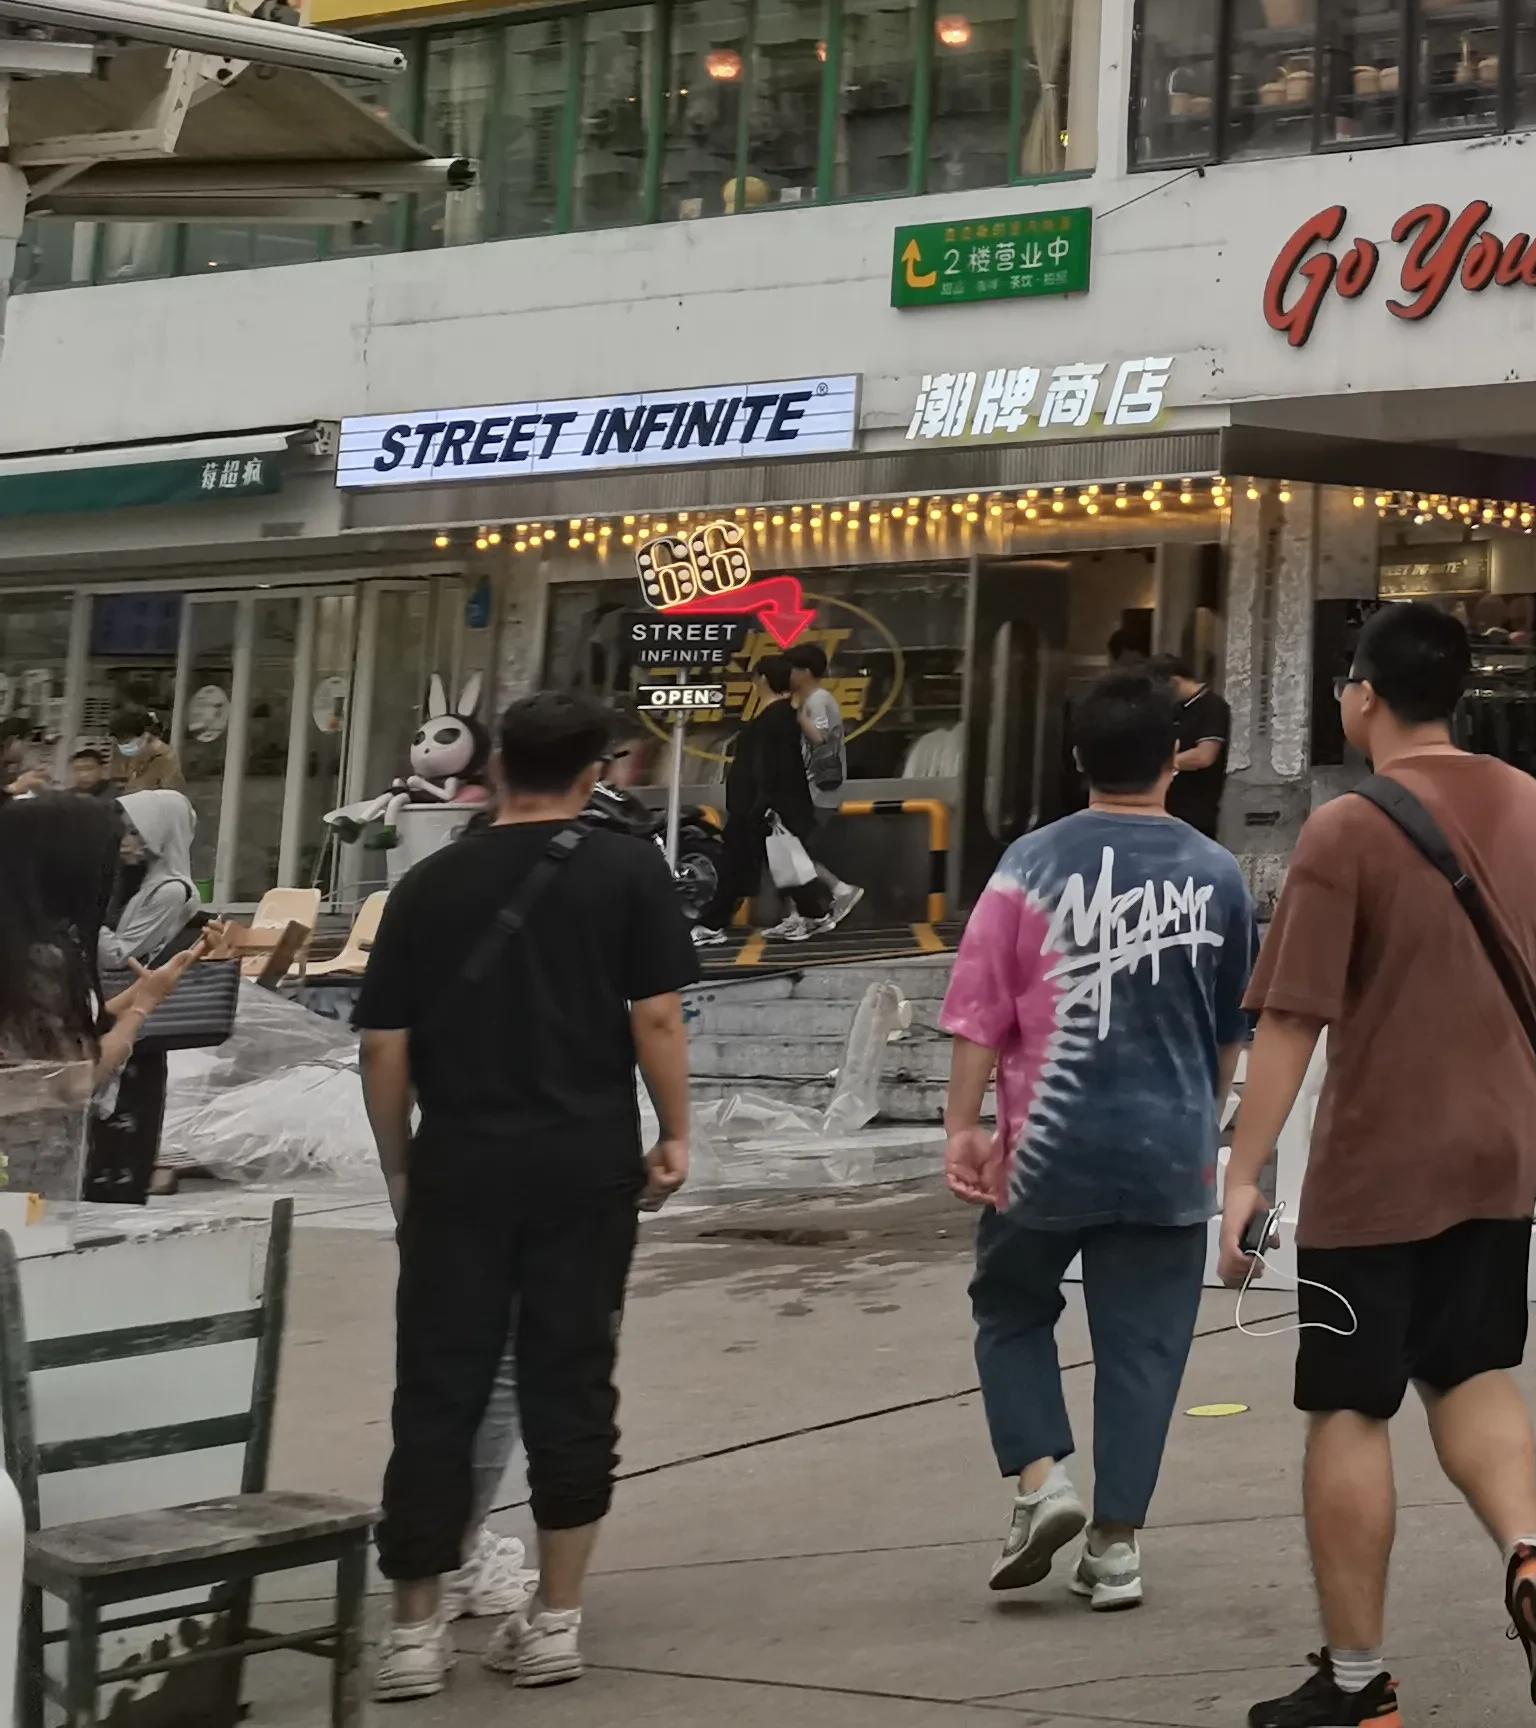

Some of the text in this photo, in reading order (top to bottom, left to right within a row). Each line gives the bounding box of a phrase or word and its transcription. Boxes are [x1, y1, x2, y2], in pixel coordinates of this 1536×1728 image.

[943, 234, 1070, 276] 2楼营业中
[1262, 204, 1380, 347] Go
[905, 356, 1175, 440] 潮牌商店
[373, 390, 813, 474] STREET INFINITE
[631, 623, 737, 642] STREET
[640, 648, 724, 663] INFINITE
[651, 689, 711, 705] OPEN
